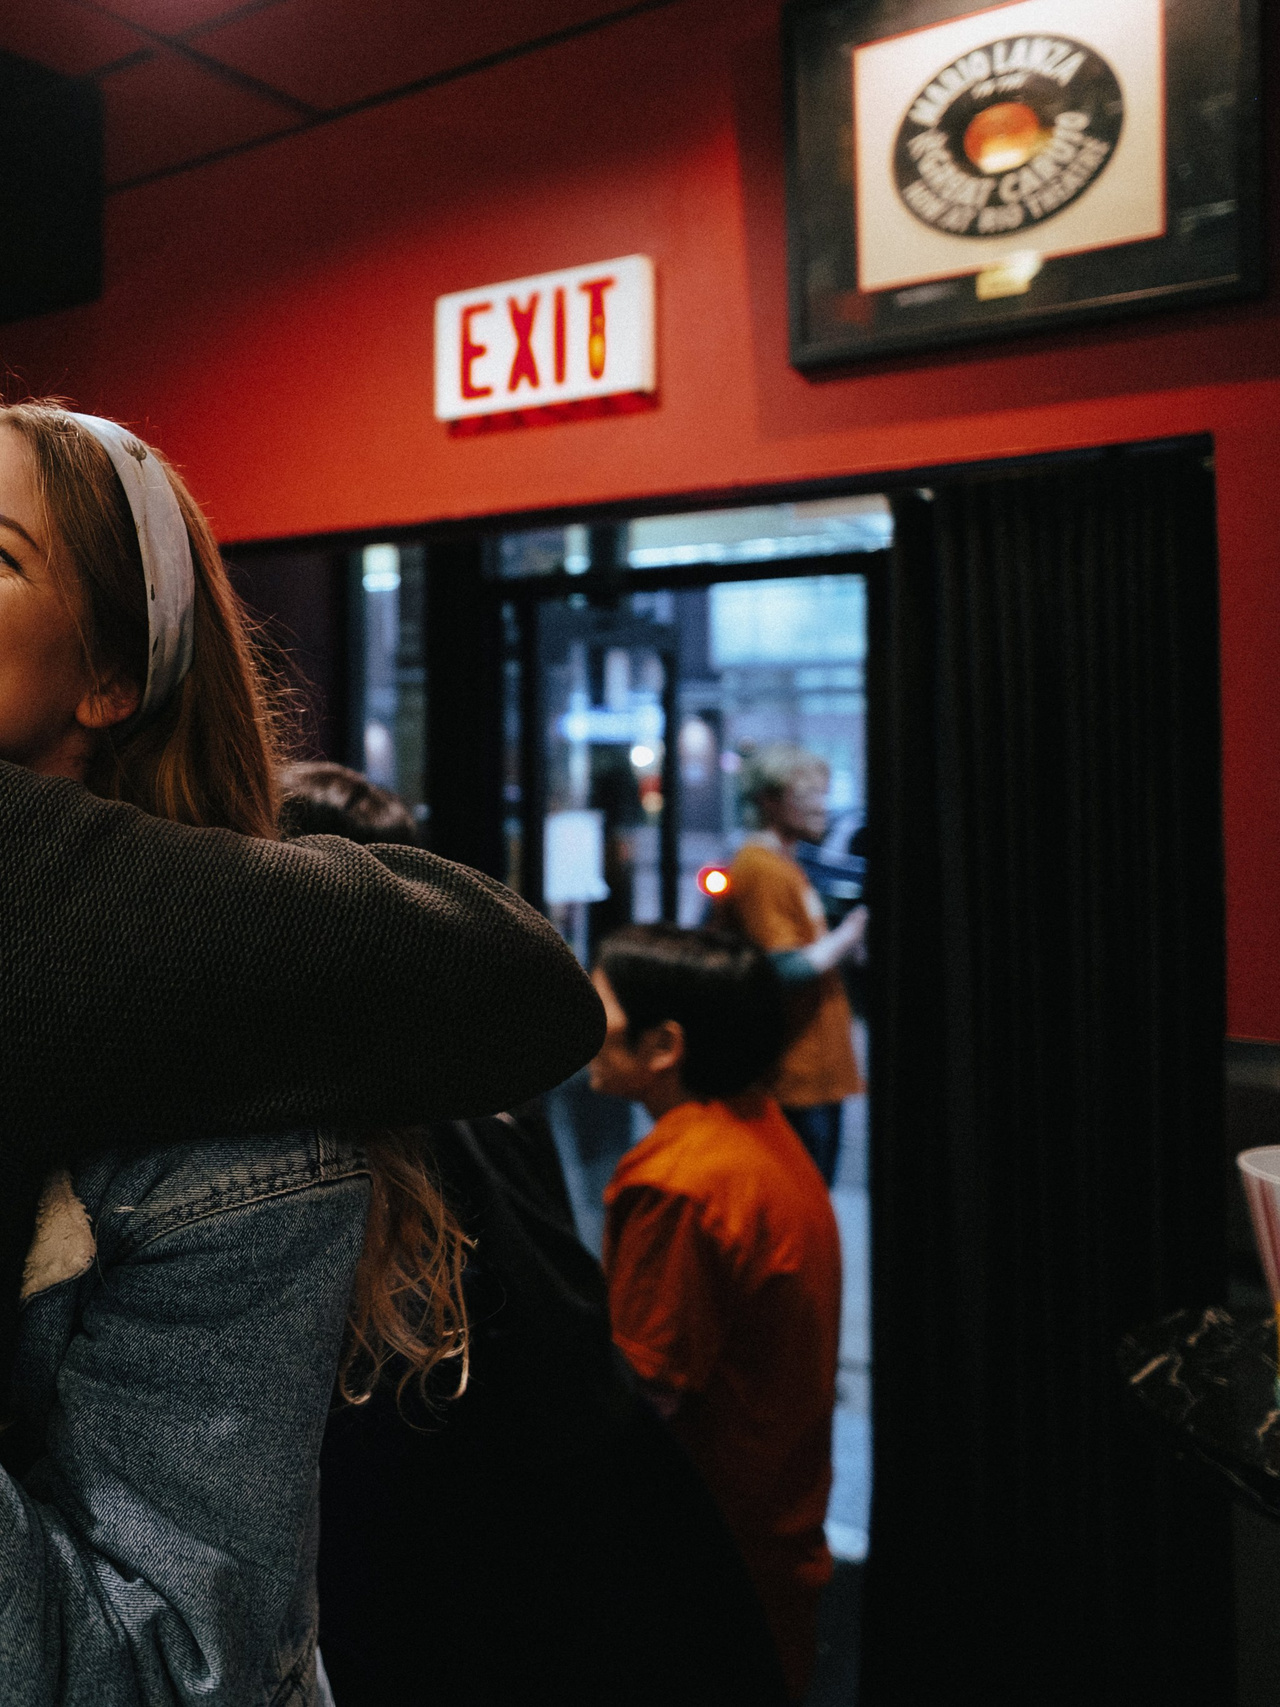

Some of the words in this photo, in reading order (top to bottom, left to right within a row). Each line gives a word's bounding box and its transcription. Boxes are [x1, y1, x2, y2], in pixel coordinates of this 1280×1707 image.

[907, 50, 992, 127] MARIO
[992, 38, 1088, 87] LANZA
[998, 111, 1091, 203] CARUSO
[460, 276, 616, 400] EXIT
